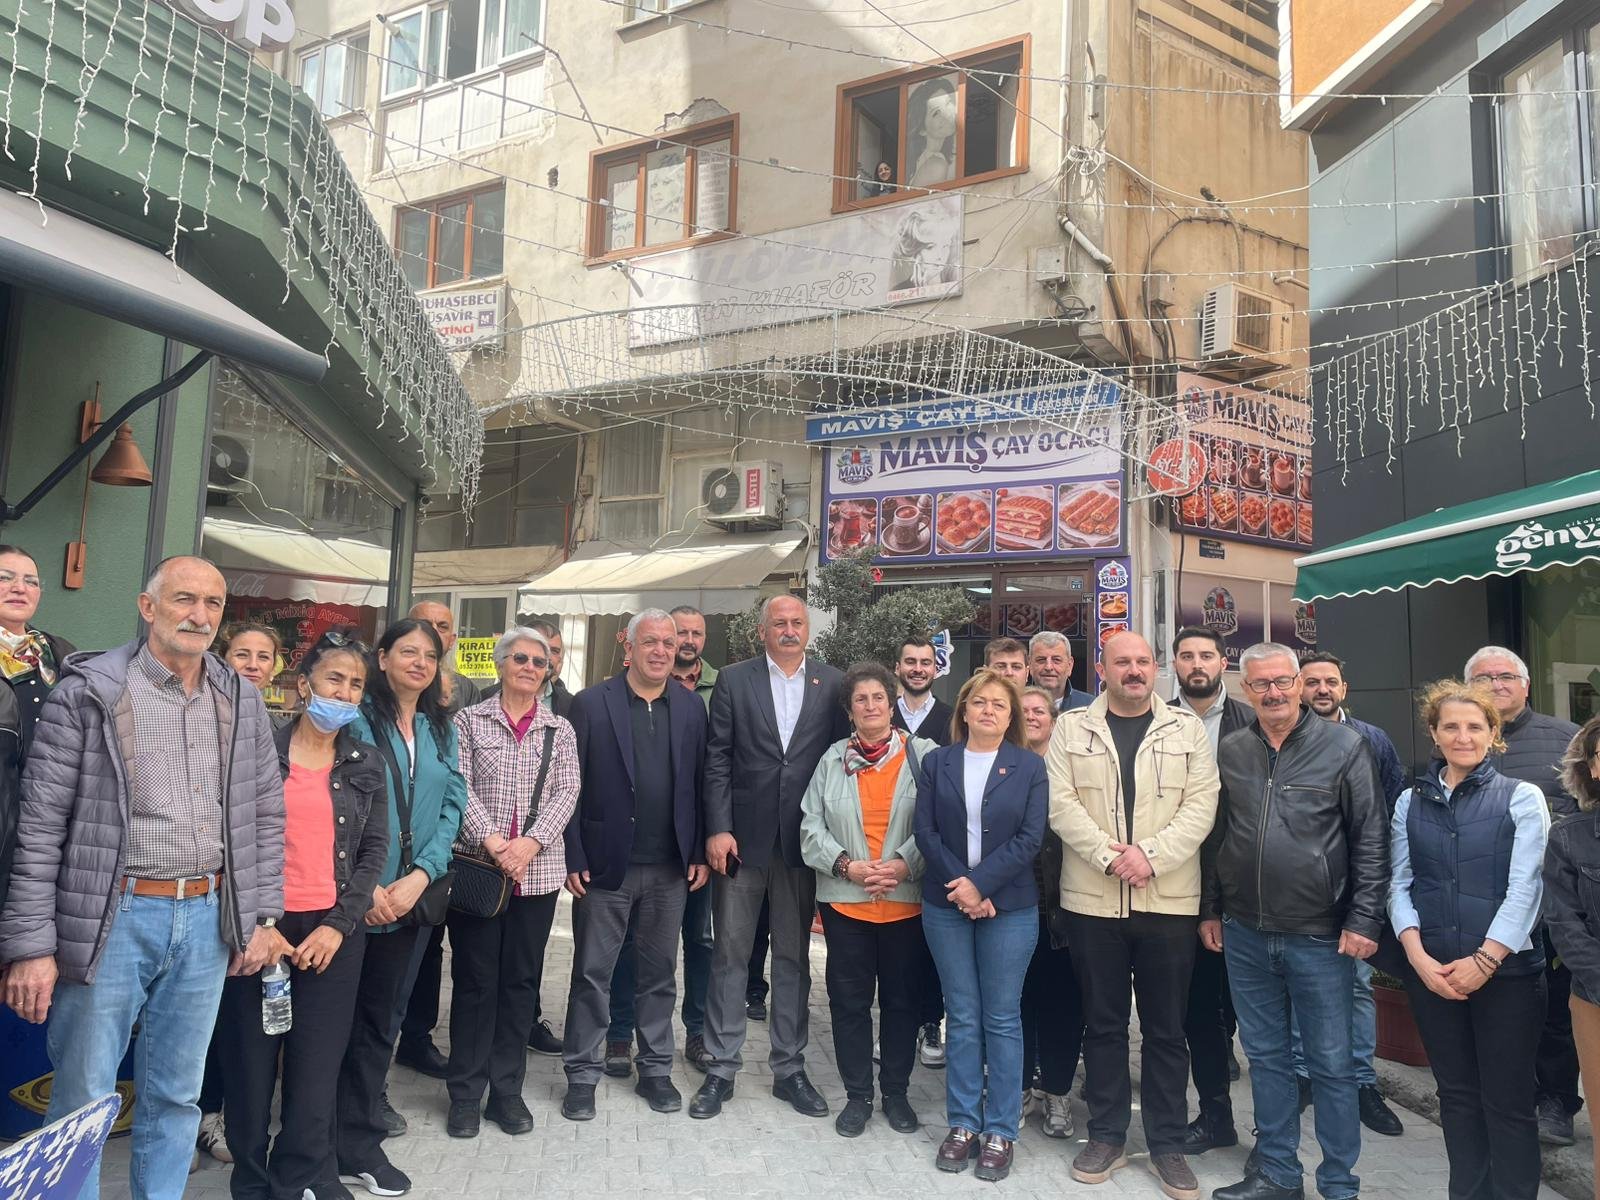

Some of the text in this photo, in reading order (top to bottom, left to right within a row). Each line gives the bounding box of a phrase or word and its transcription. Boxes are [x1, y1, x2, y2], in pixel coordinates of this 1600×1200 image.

[821, 411, 904, 436] MAVİŞ
[879, 427, 988, 473] MAVİŞ
[992, 434, 1034, 459] ÇAY
[459, 641, 497, 651] KİRALI
[461, 650, 495, 664] İŞYER
